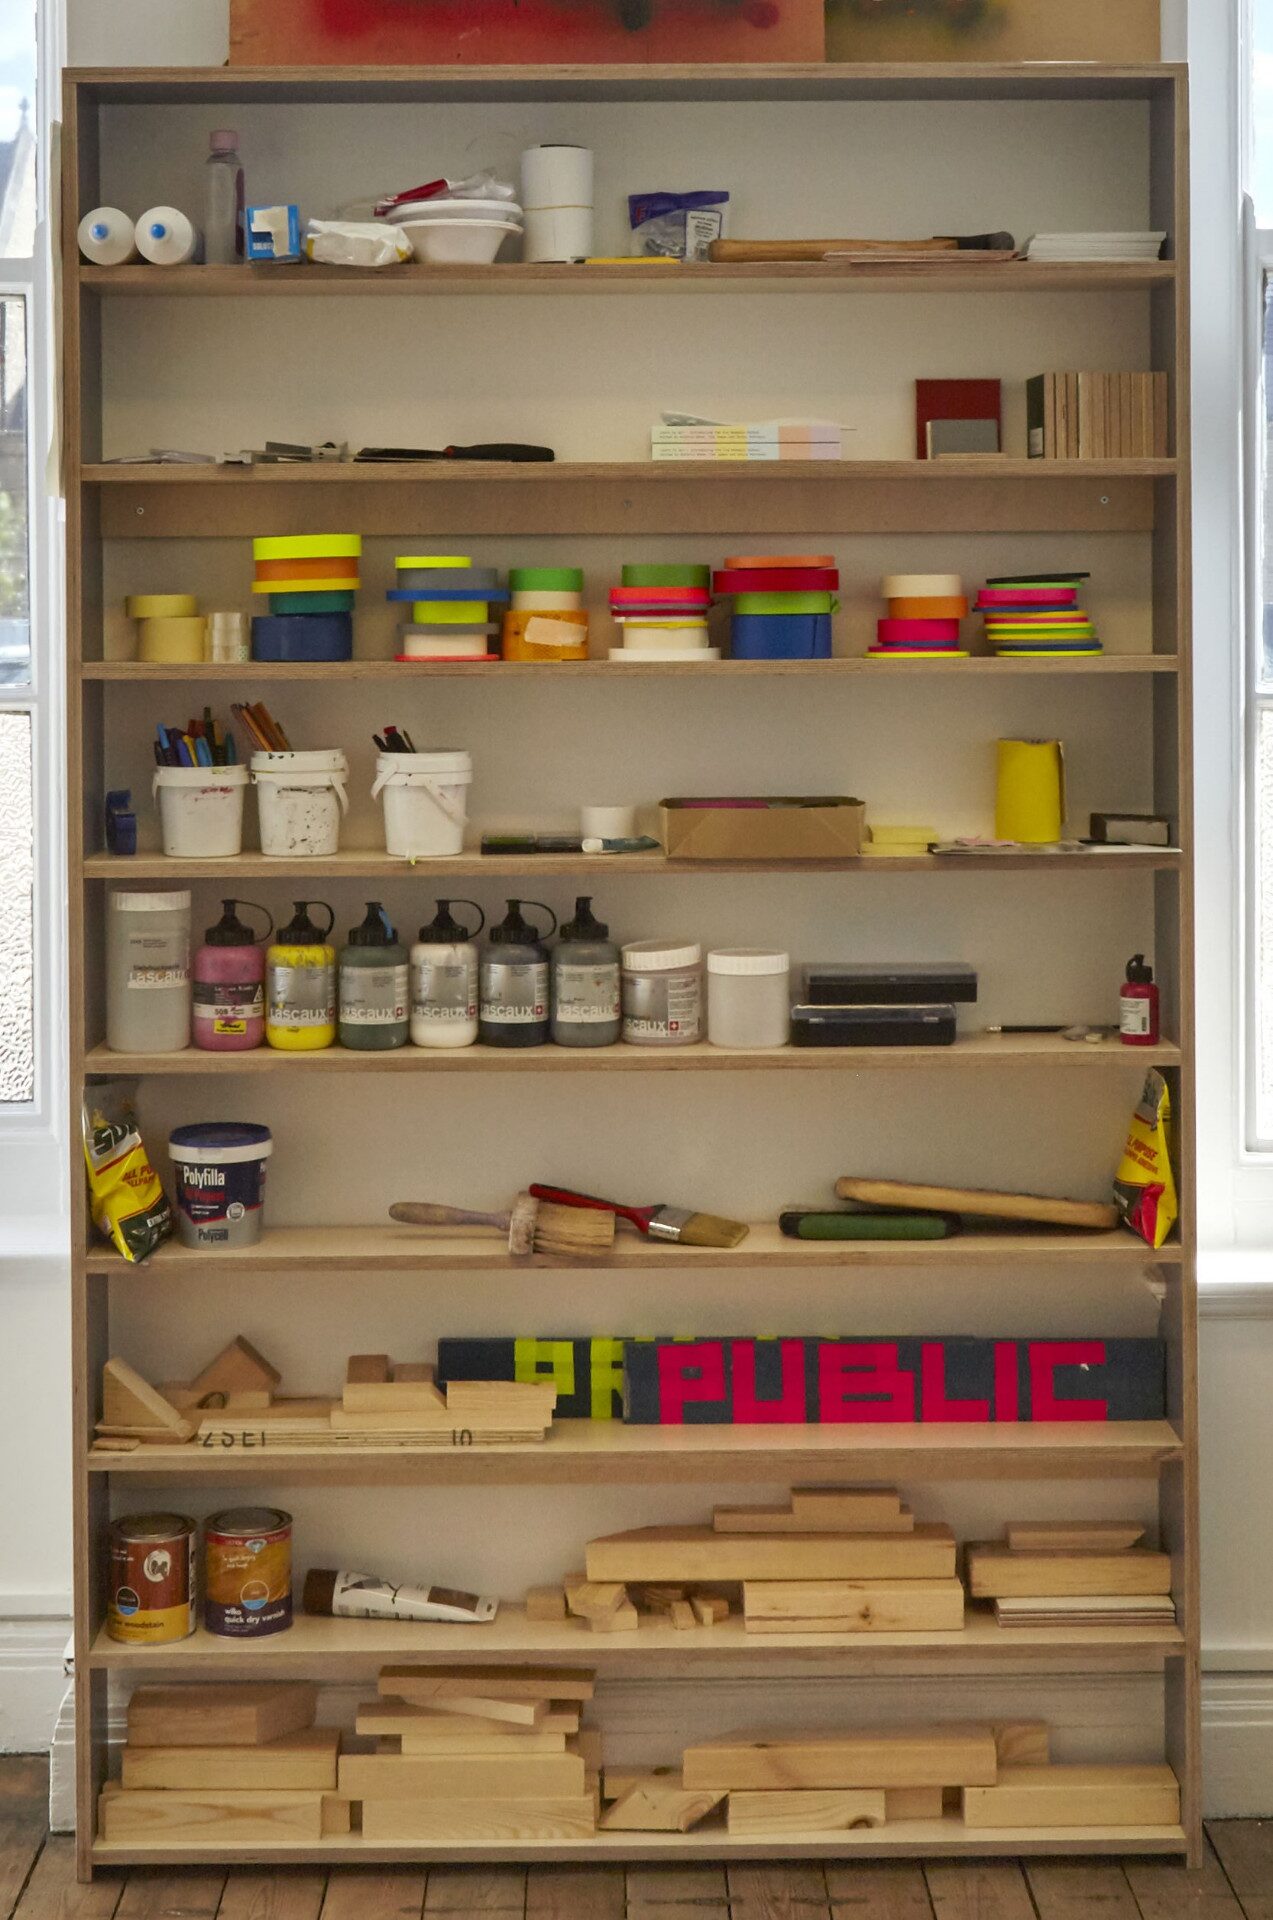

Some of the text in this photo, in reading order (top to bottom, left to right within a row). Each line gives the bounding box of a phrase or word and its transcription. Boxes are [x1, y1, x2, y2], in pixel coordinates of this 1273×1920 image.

[183, 1165, 225, 1189] Polyfilla
[656, 1339, 1108, 1425] PUBLIC
[224, 1616, 245, 1624] quick
[246, 1616, 260, 1625] dry
